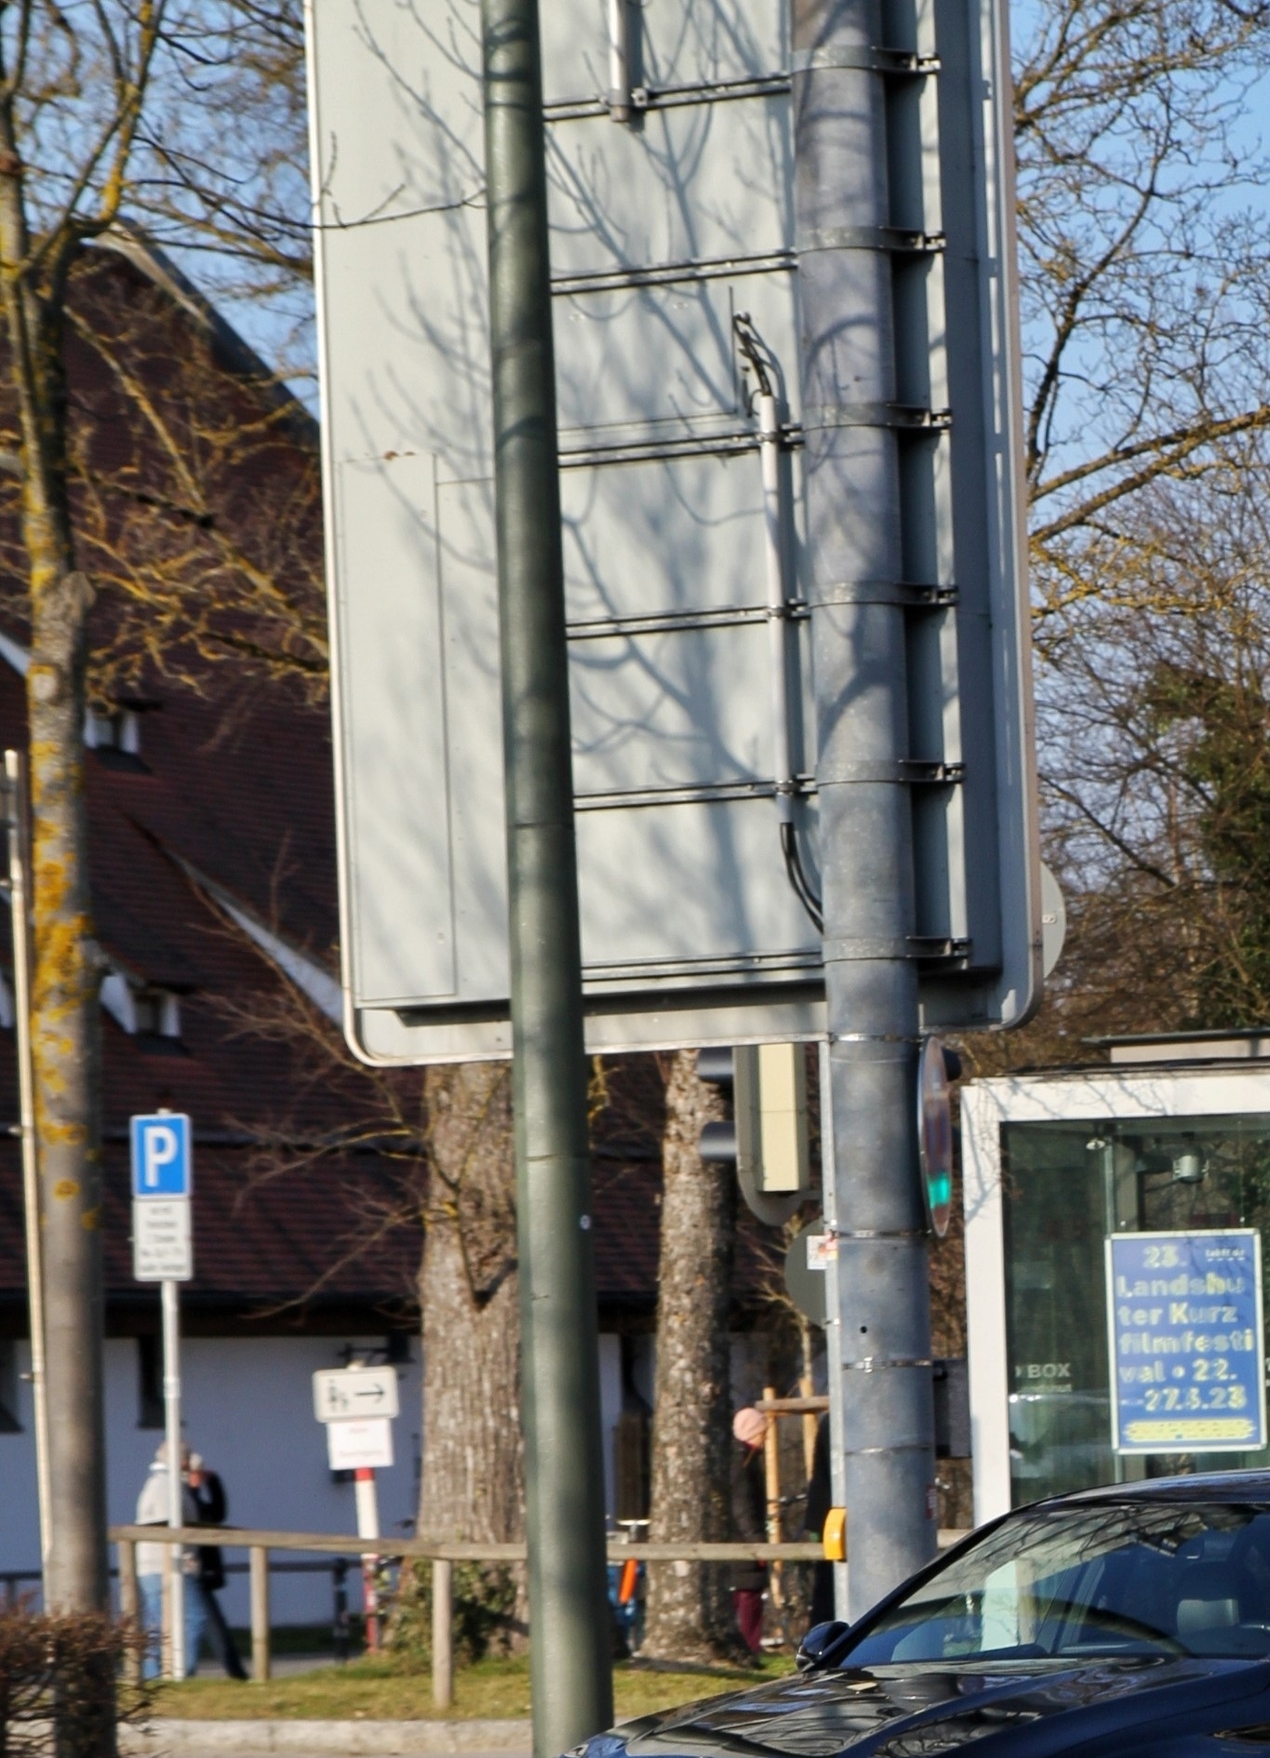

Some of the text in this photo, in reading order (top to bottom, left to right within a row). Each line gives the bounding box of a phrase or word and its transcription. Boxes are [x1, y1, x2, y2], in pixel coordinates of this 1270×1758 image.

[143, 1126, 178, 1187] P
[1142, 1245, 1188, 1269] 23.
[1116, 1272, 1246, 1298] Landshu
[1118, 1302, 1238, 1326] ter Kurz
[1119, 1328, 1255, 1355] filmfesti
[1028, 1363, 1072, 1379] BOX
[1119, 1360, 1166, 1383] val
[1192, 1358, 1238, 1382] 22.
